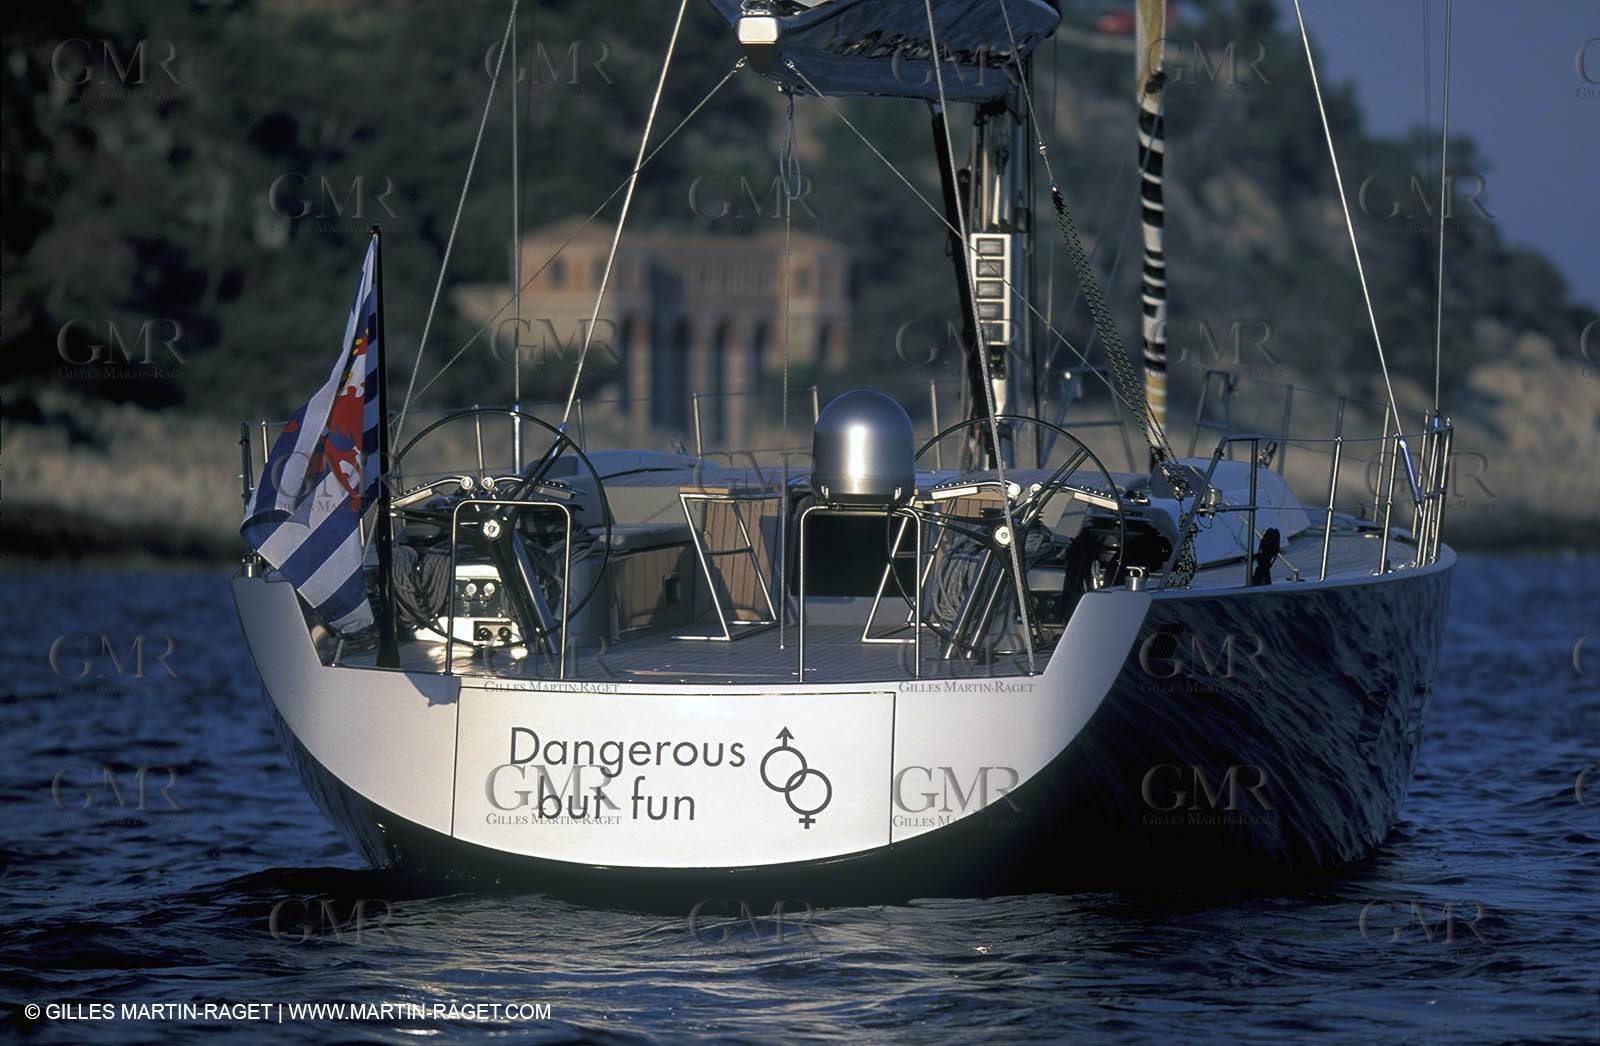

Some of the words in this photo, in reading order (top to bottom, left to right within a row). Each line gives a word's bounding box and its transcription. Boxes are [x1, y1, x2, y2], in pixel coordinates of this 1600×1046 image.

[510, 727, 746, 778] Dangerous
[538, 775, 606, 820] but
[631, 775, 696, 820] fun
